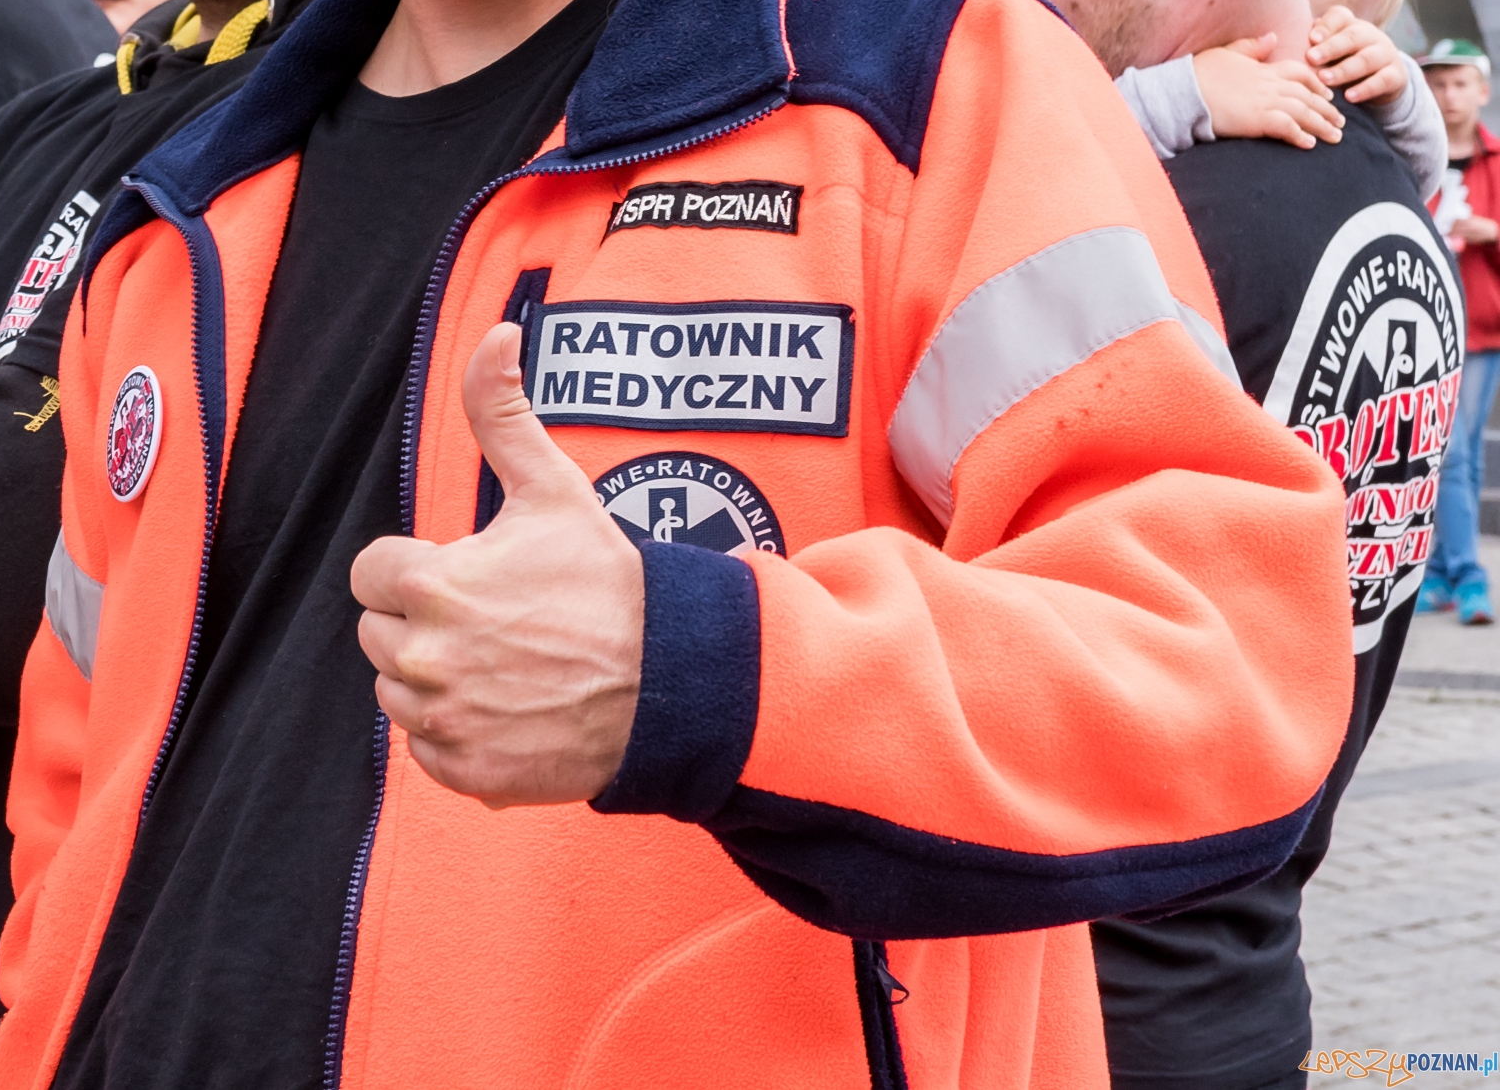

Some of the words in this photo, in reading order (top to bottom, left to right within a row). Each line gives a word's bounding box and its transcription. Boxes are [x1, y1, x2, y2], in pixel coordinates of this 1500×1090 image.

[681, 191, 792, 226] POZNAŃ
[551, 322, 824, 360] RATOWNIK
[1301, 255, 1388, 426] STWOWE
[540, 371, 827, 412] MEDYCZNY
[657, 460, 777, 554] RATOWNIC
